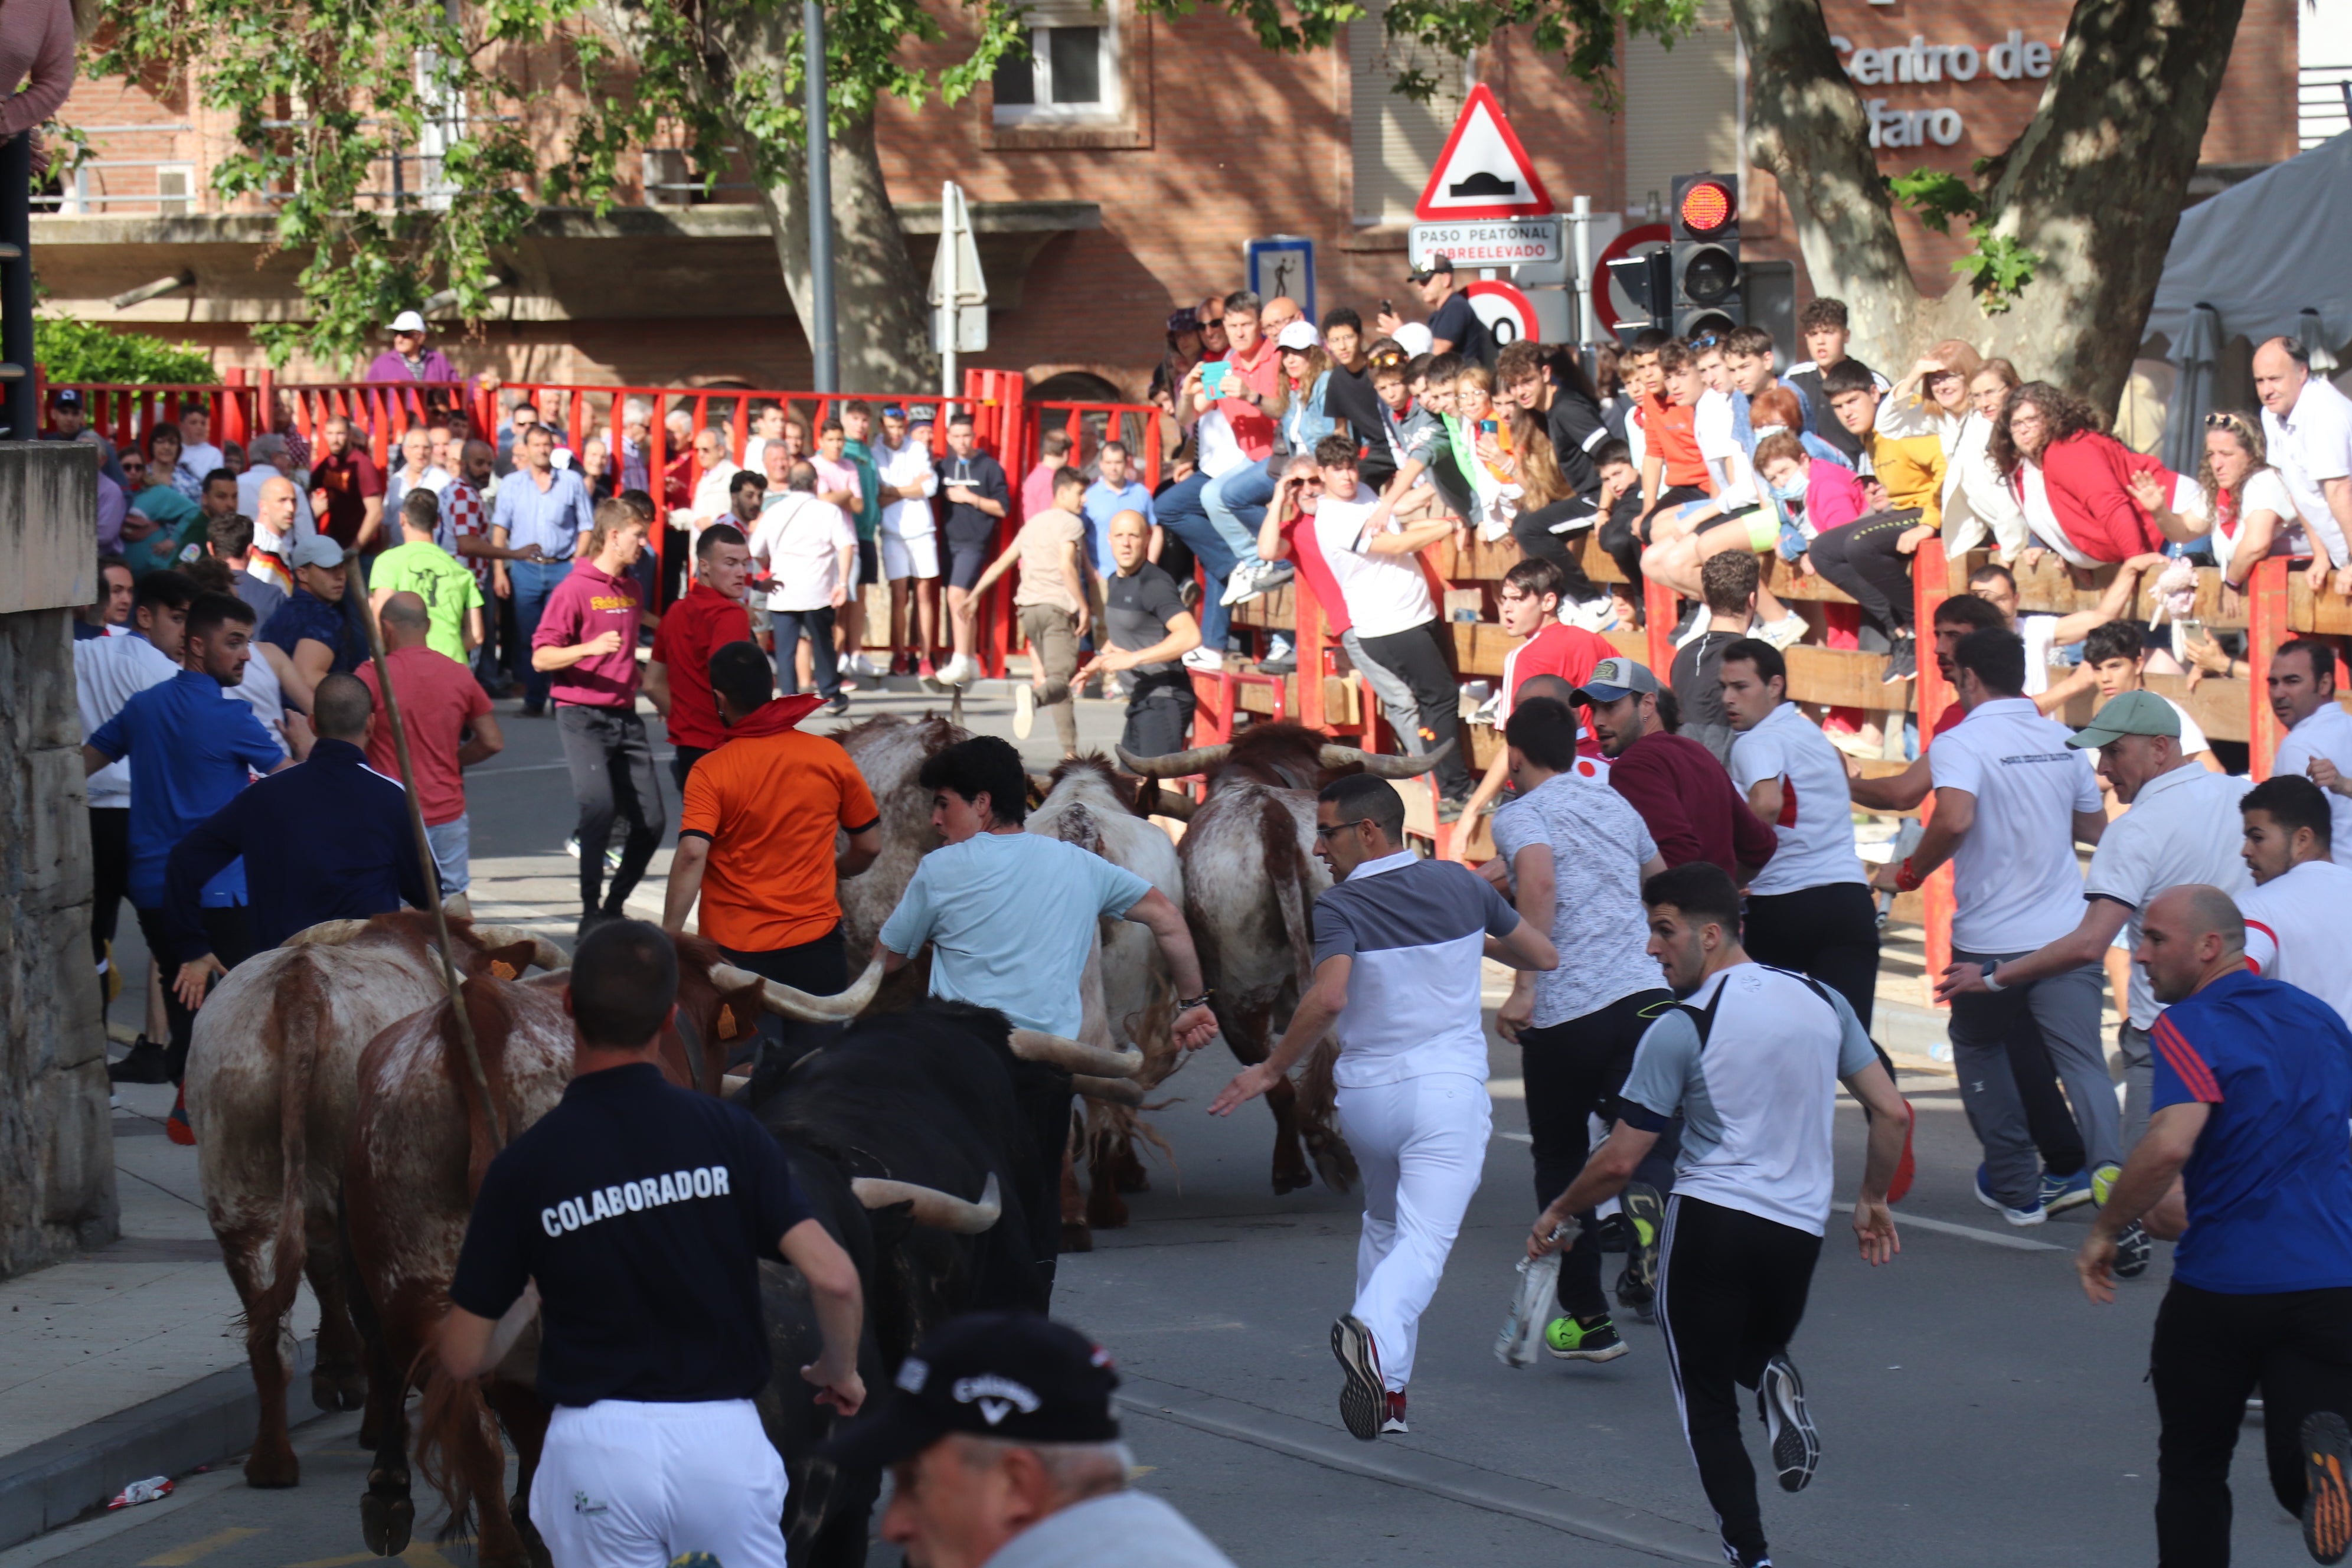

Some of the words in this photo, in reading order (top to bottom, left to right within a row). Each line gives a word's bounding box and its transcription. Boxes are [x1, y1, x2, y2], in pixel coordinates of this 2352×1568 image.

[1987, 30, 2052, 80] de
[1420, 230, 1461, 243] PASO
[1470, 227, 1549, 241] PEATONAL
[541, 1165, 730, 1238] COLABORADOR
